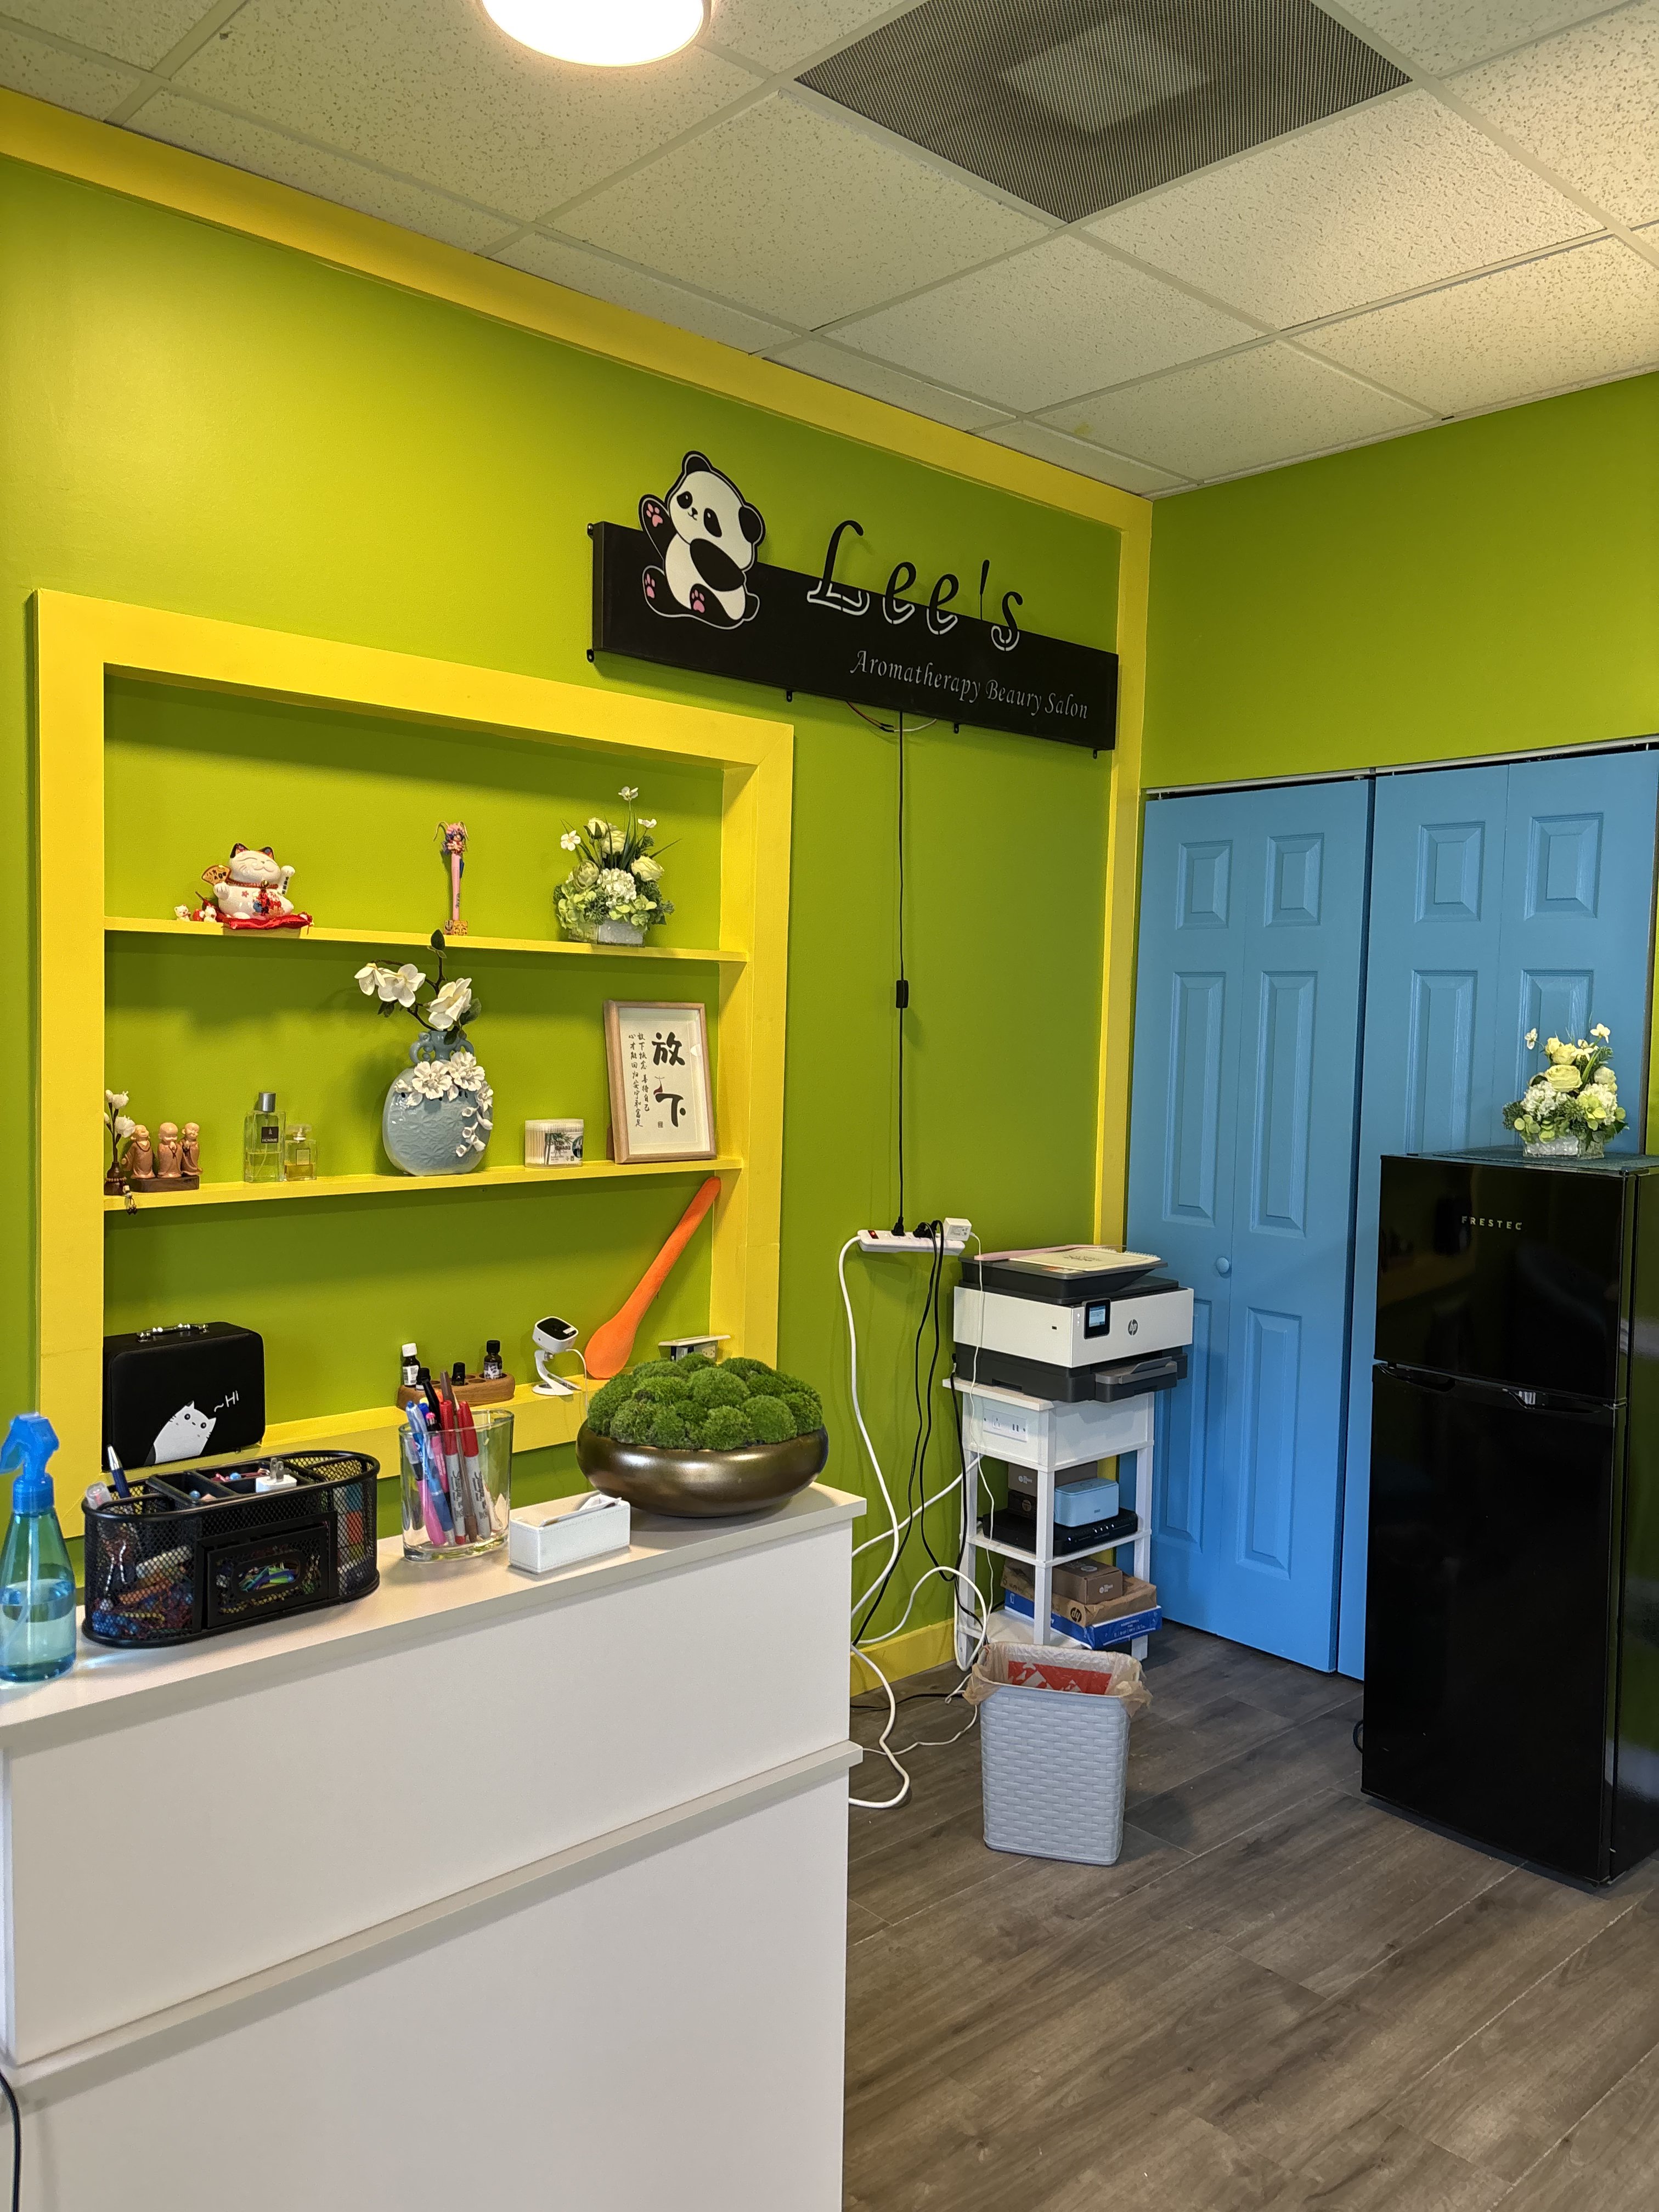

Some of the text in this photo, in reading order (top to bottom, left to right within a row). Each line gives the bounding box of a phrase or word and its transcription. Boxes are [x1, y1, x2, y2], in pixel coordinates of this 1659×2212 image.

[806, 520, 1024, 652] Lee's
[849, 650, 981, 703] Aromatherapy
[1045, 692, 1088, 719] Salon
[651, 1031, 686, 1128] 放下
[1461, 1215, 1522, 1231] FRESTEC
[1128, 1319, 1138, 1335] hp
[1070, 1607, 1082, 1623] hp
